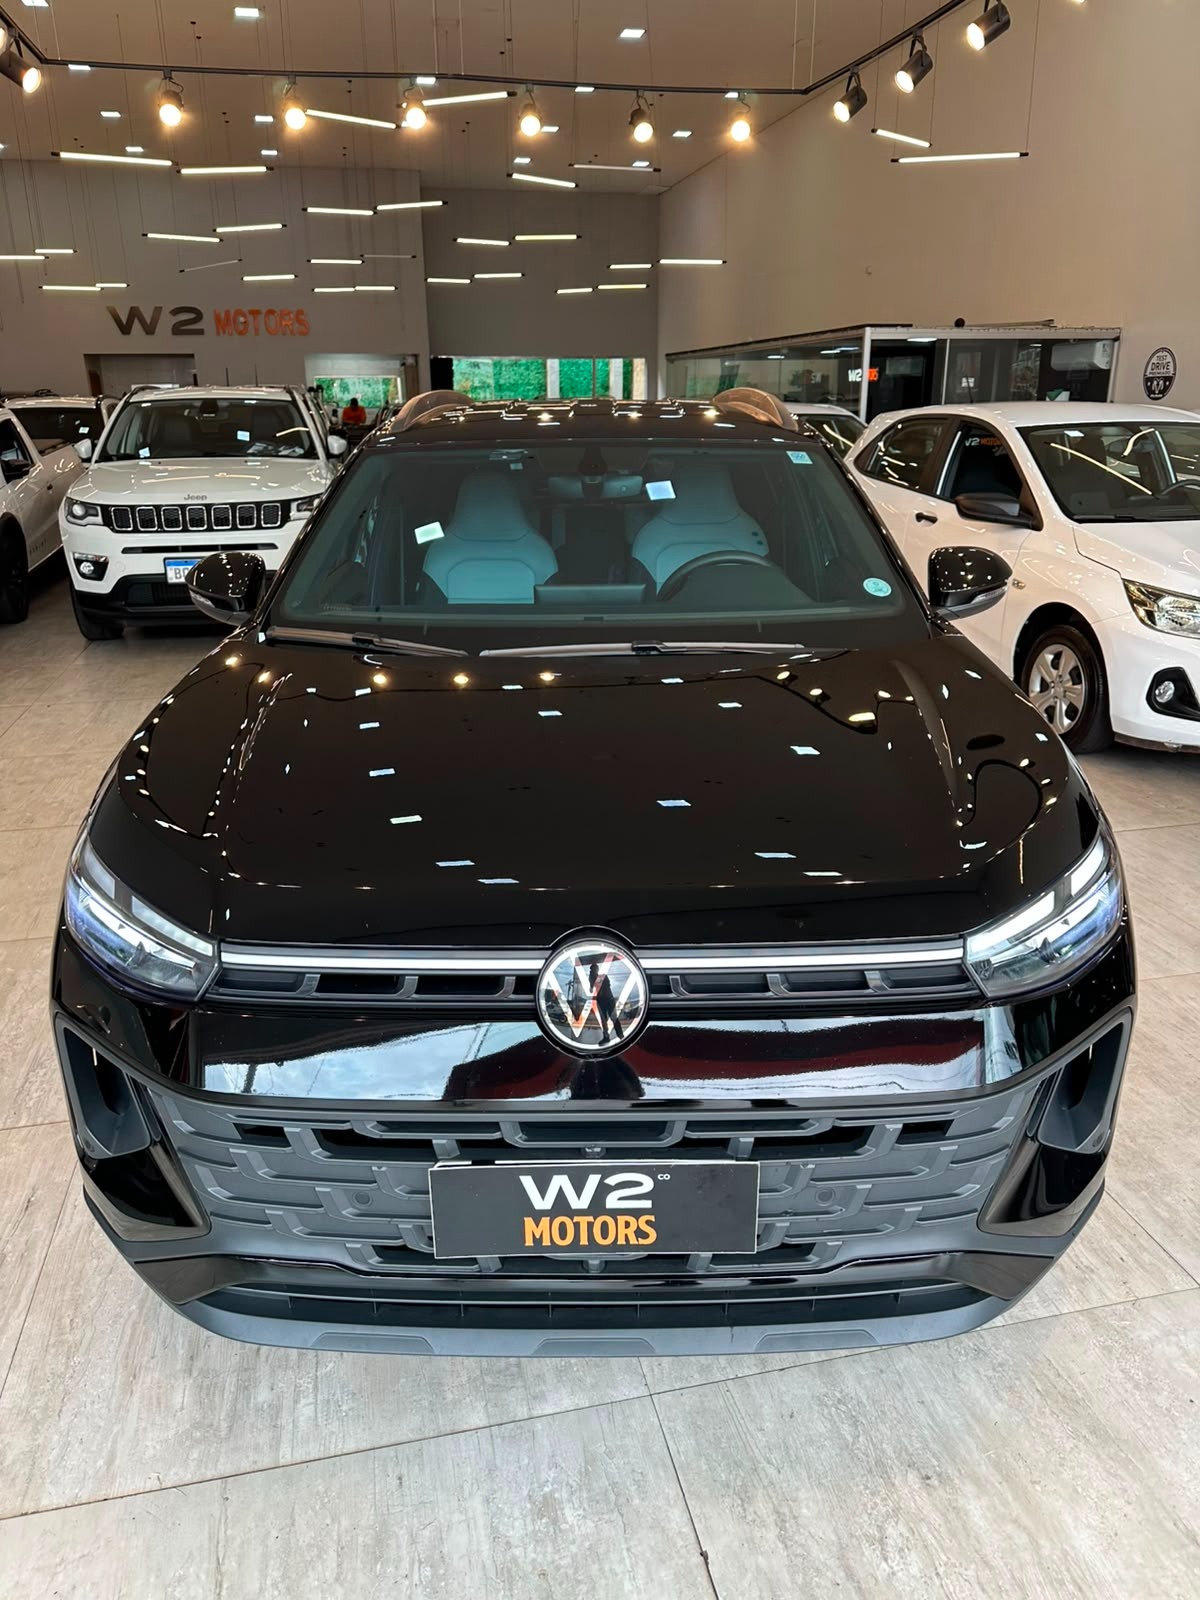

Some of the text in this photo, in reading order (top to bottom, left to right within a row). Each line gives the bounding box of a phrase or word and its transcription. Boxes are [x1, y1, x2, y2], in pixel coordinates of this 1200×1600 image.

[106, 306, 311, 337] W2 MOTORS
[848, 368, 862, 382] W2
[1151, 361, 1171, 371] DRIVE
[183, 493, 208, 501] Jeep
[518, 1172, 655, 1210] W2
[524, 1214, 658, 1247] MOTORS
